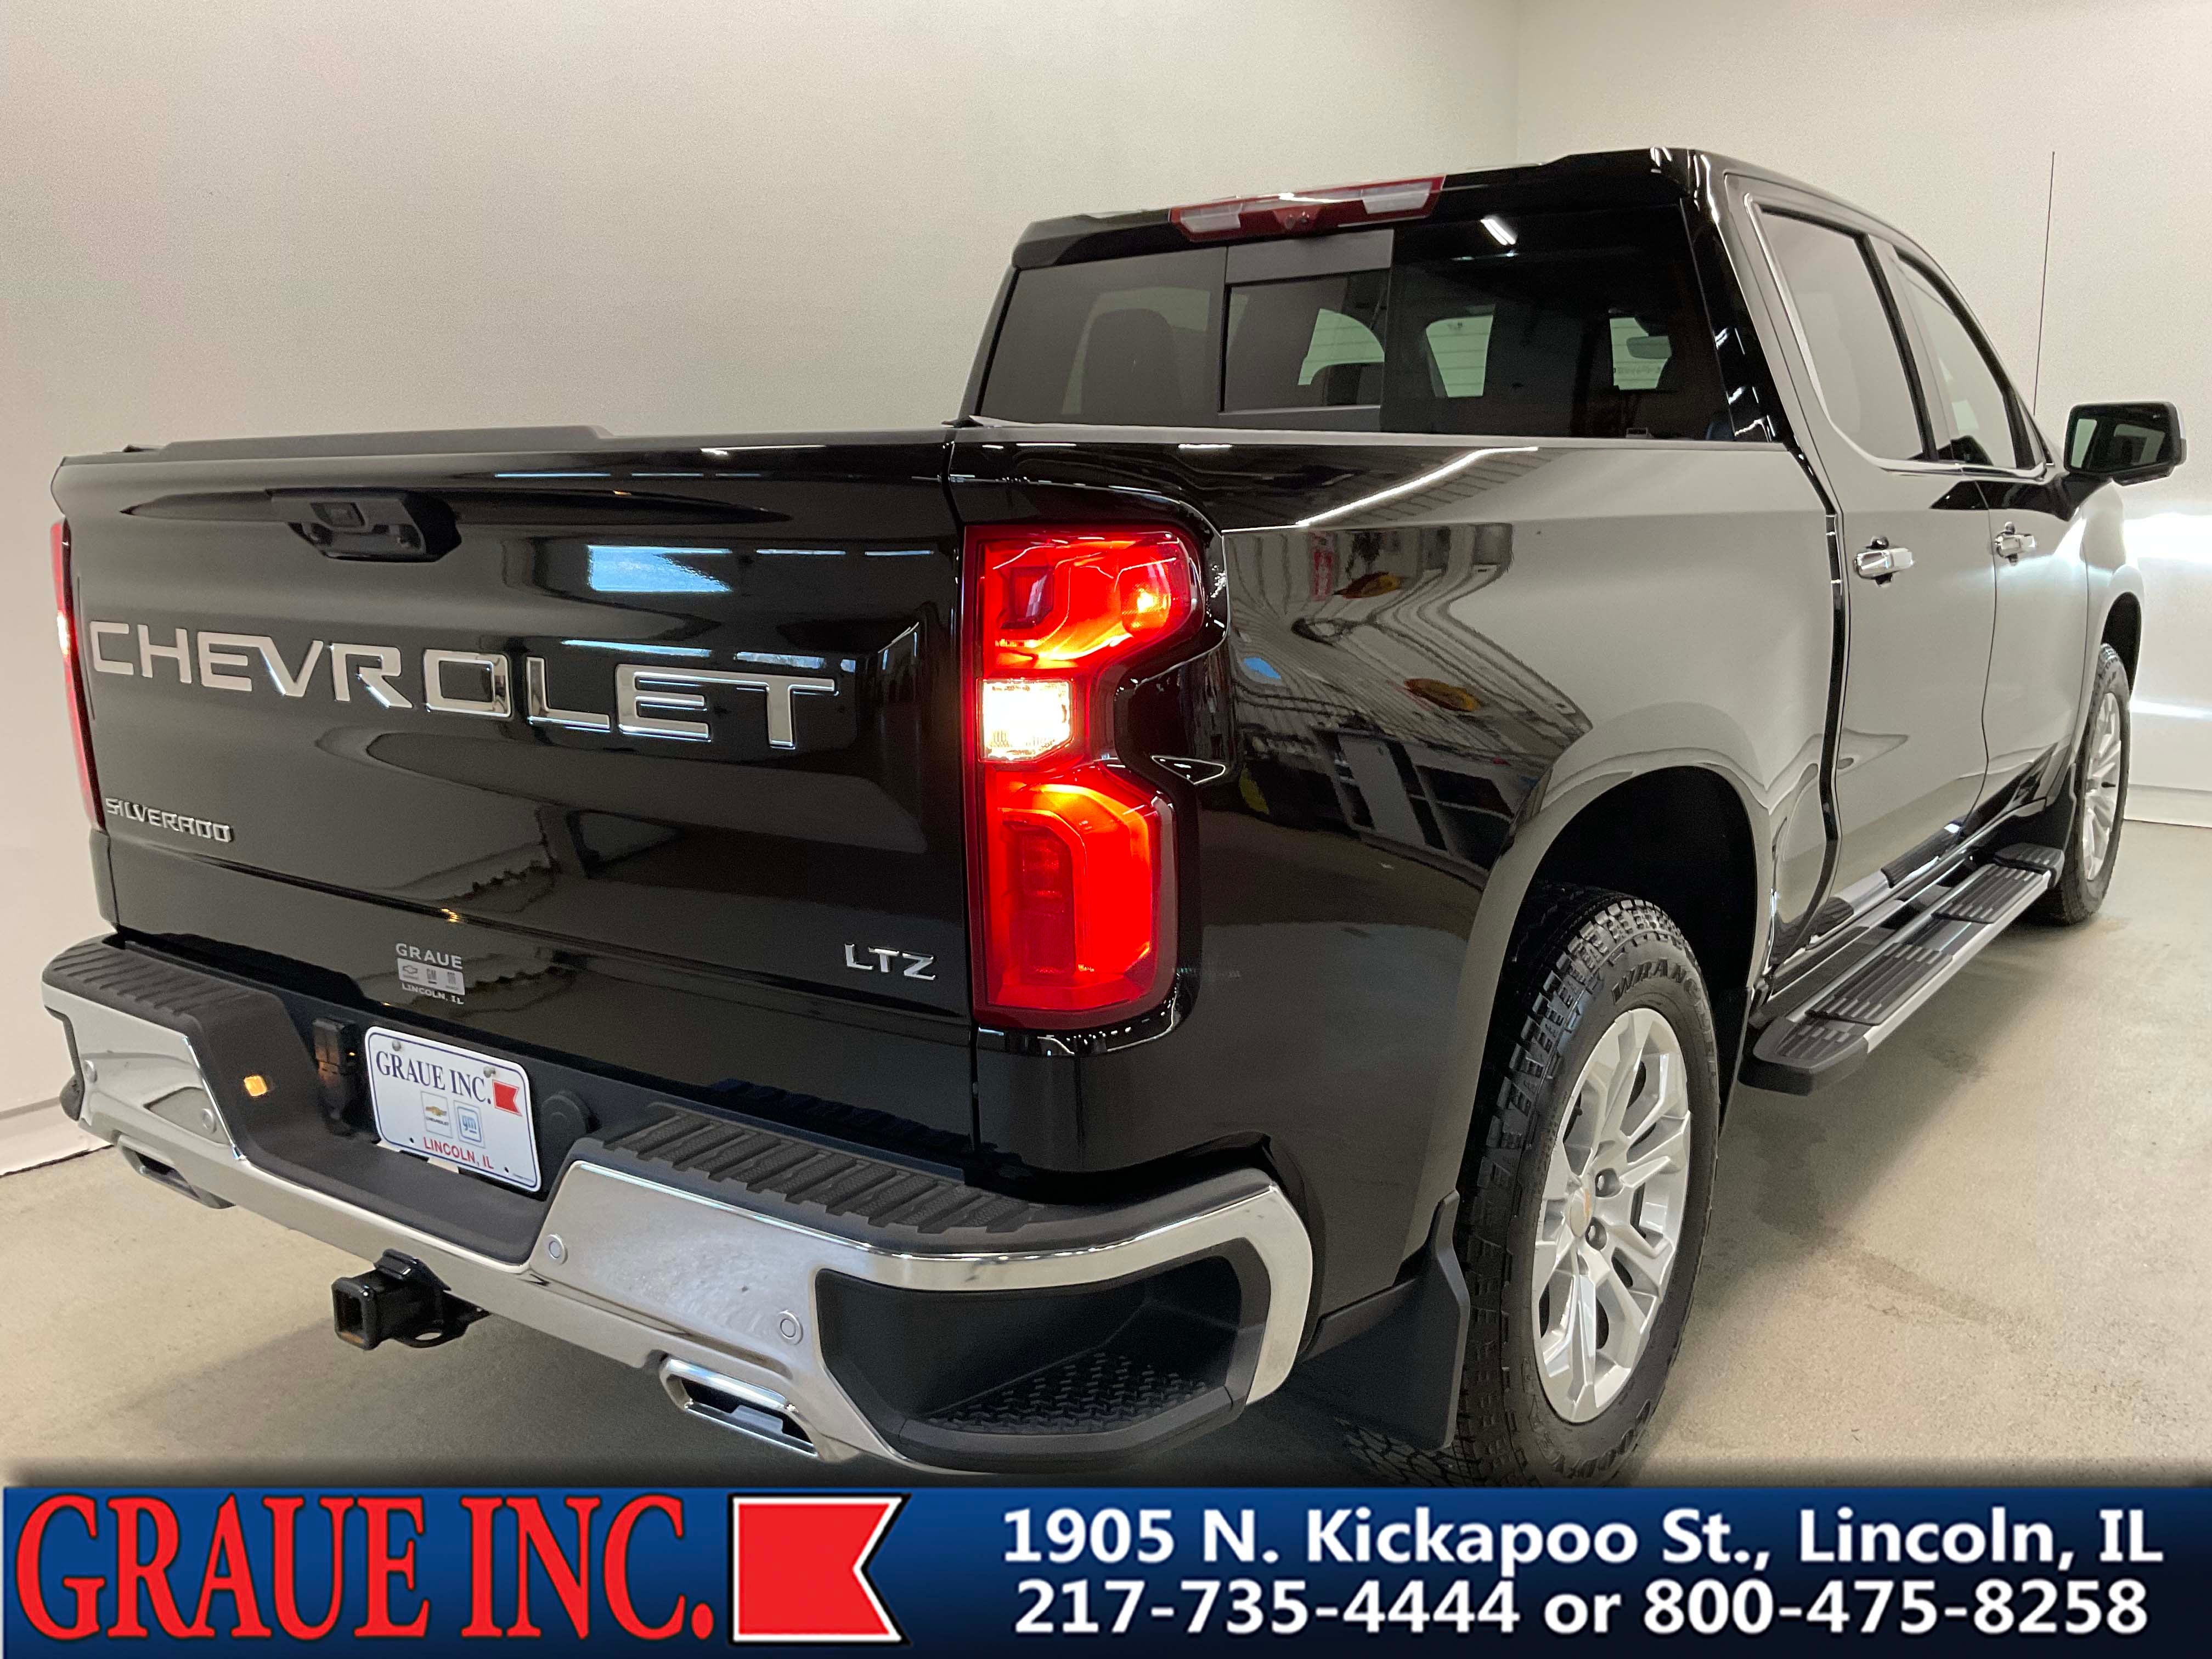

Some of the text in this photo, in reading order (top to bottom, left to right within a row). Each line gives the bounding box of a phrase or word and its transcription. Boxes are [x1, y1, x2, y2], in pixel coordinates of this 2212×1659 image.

[89, 620, 837, 748] CHEVROLET
[105, 797, 232, 843] SILVERADO
[396, 943, 463, 969] GRAUE
[844, 943, 936, 980] LTZ
[402, 983, 464, 1005] LINCOLN, IL
[376, 1051, 491, 1104] GRAUE INC.
[423, 1136, 494, 1170] LINCOLN, IL
